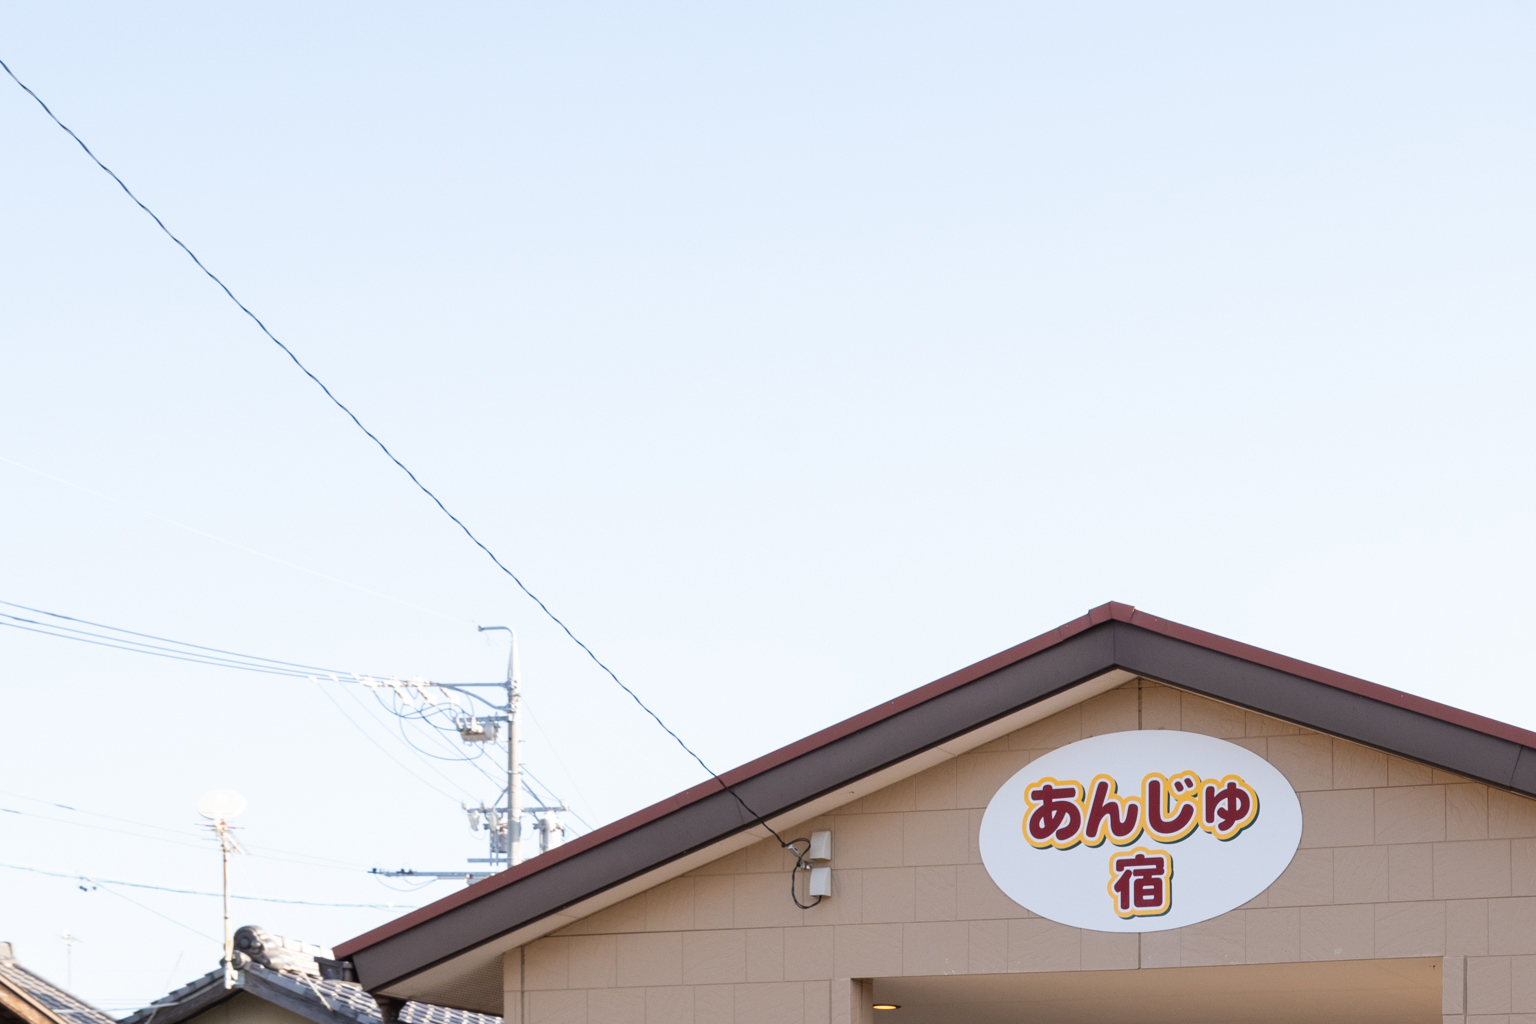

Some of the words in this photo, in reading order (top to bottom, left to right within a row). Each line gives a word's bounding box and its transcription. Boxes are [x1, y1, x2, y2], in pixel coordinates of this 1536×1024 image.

[1025, 773, 1255, 847] あんじゅ
[1110, 850, 1169, 914] 宿
